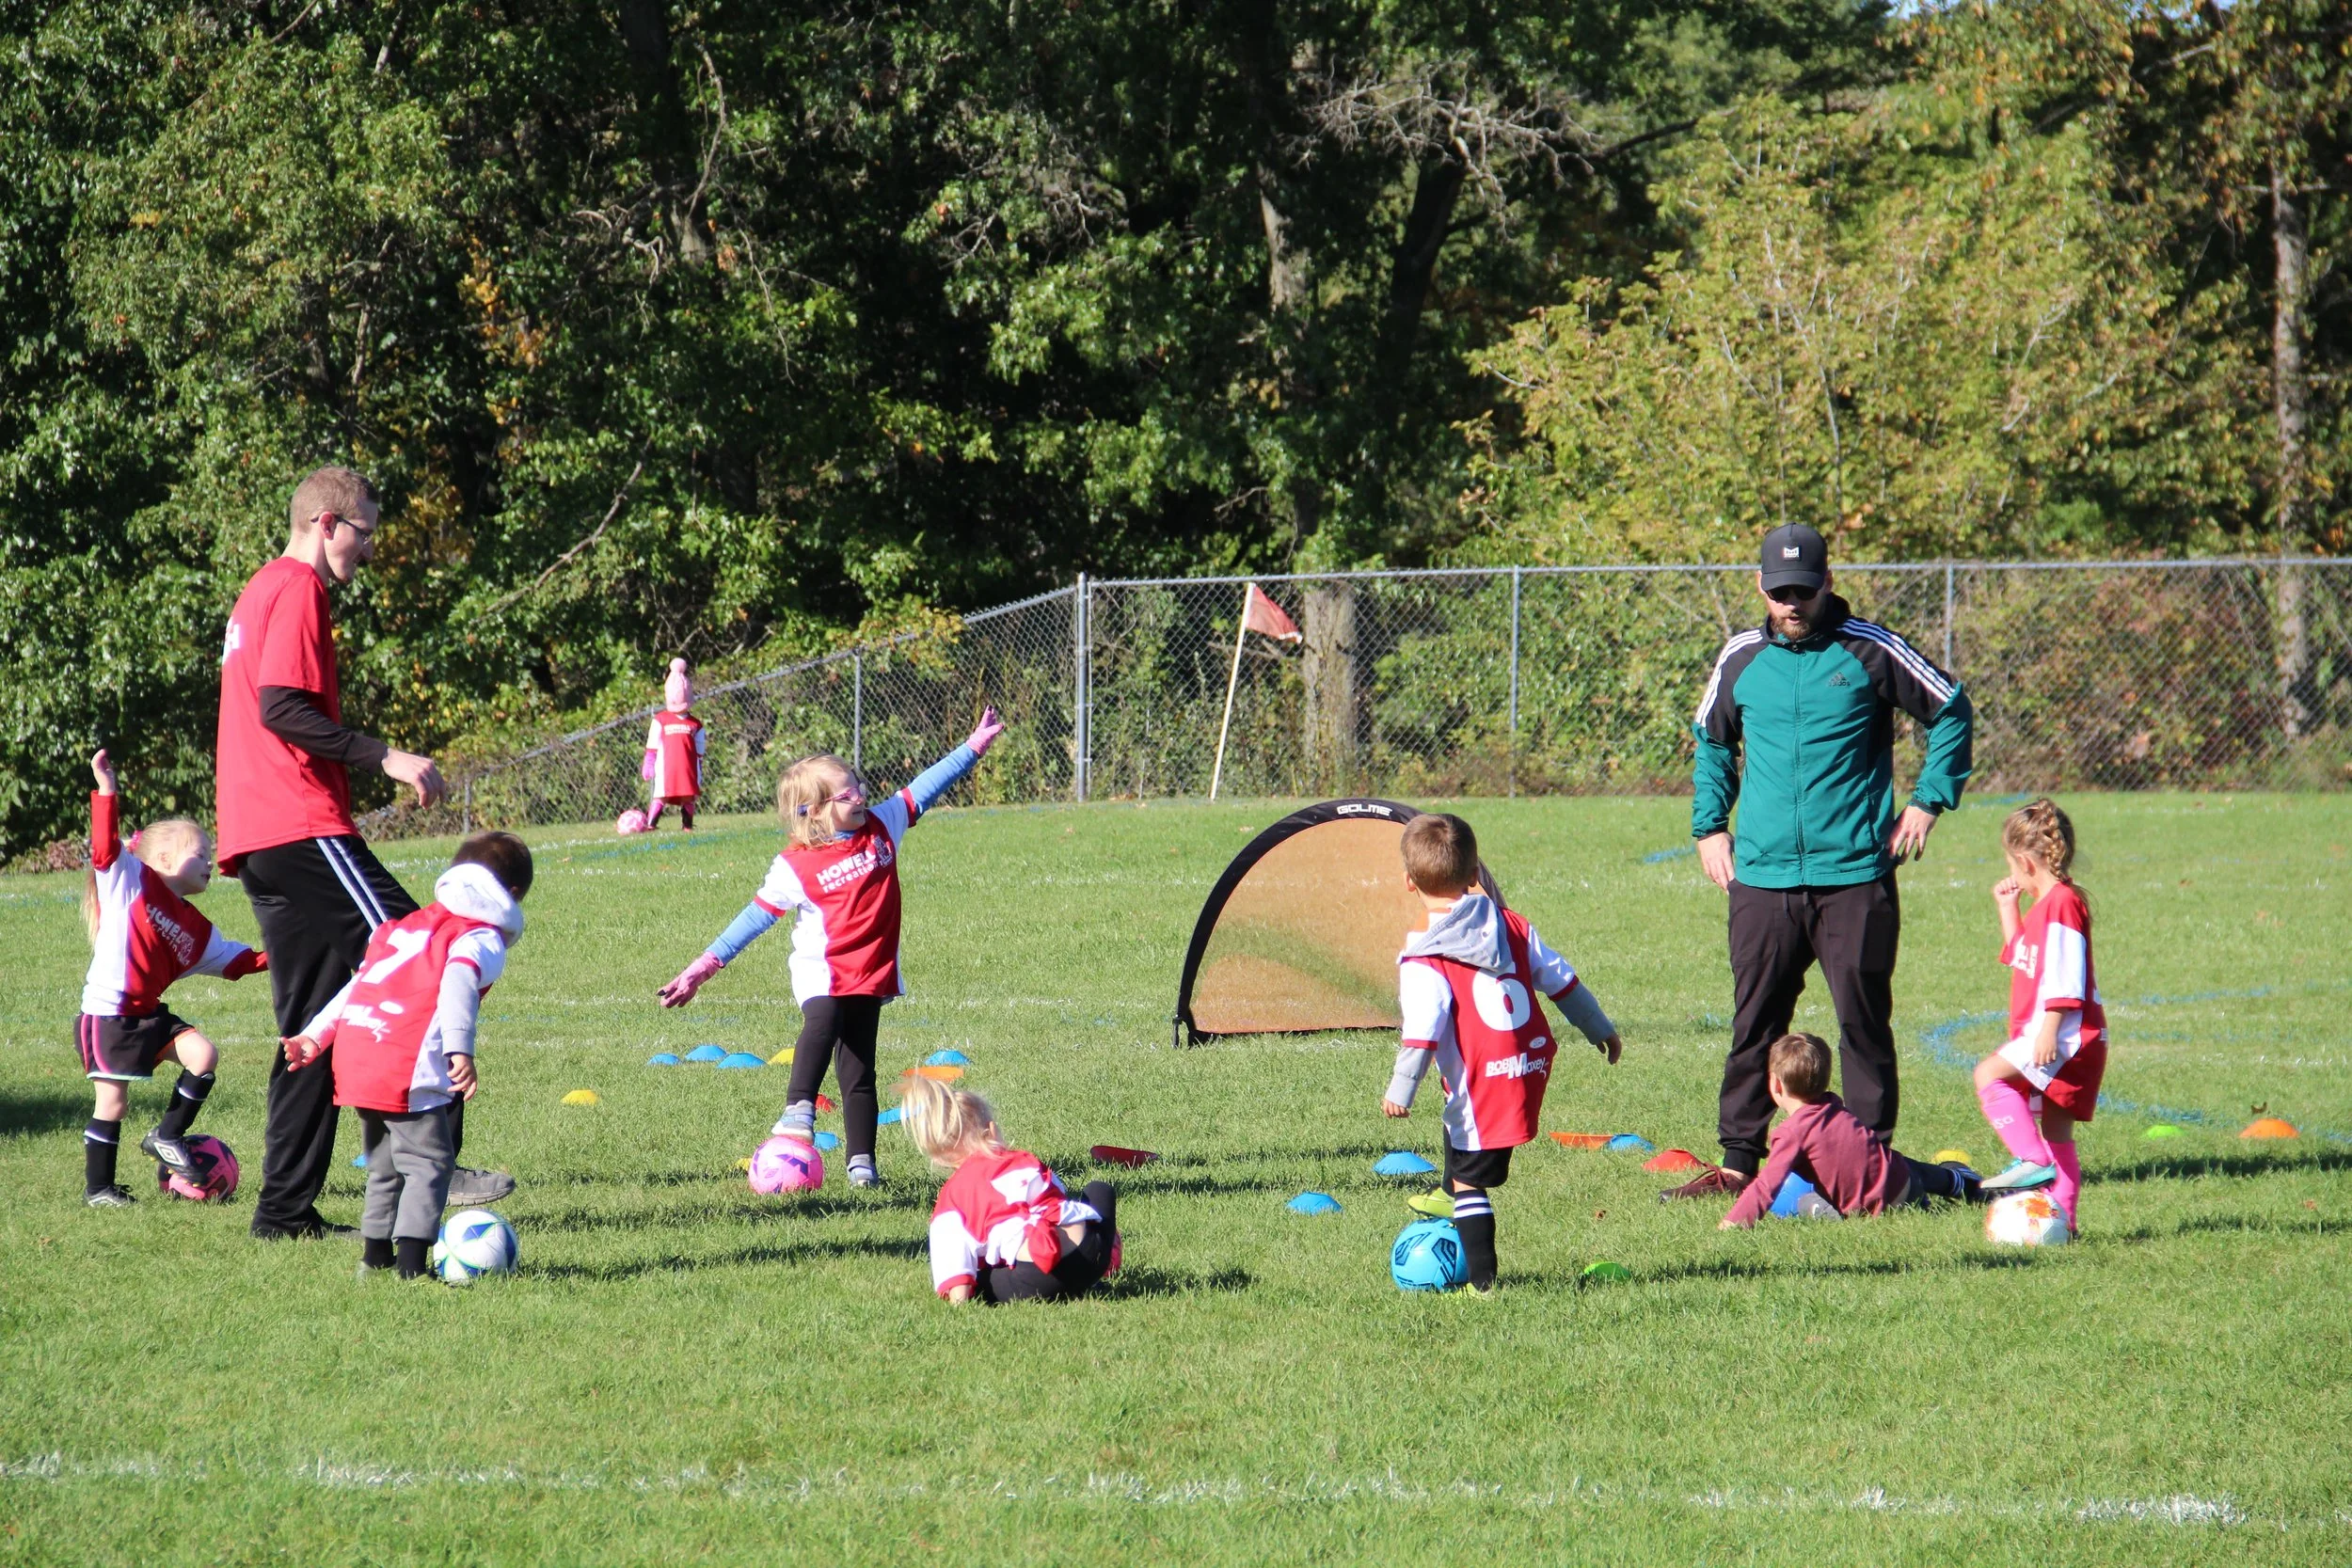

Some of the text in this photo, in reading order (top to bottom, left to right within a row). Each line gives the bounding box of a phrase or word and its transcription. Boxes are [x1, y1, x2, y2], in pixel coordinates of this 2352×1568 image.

[1337, 804, 1392, 816] GOLME
[816, 849, 876, 885] HOWELL
[361, 927, 431, 984] 7
[1472, 964, 1531, 1032] 6
